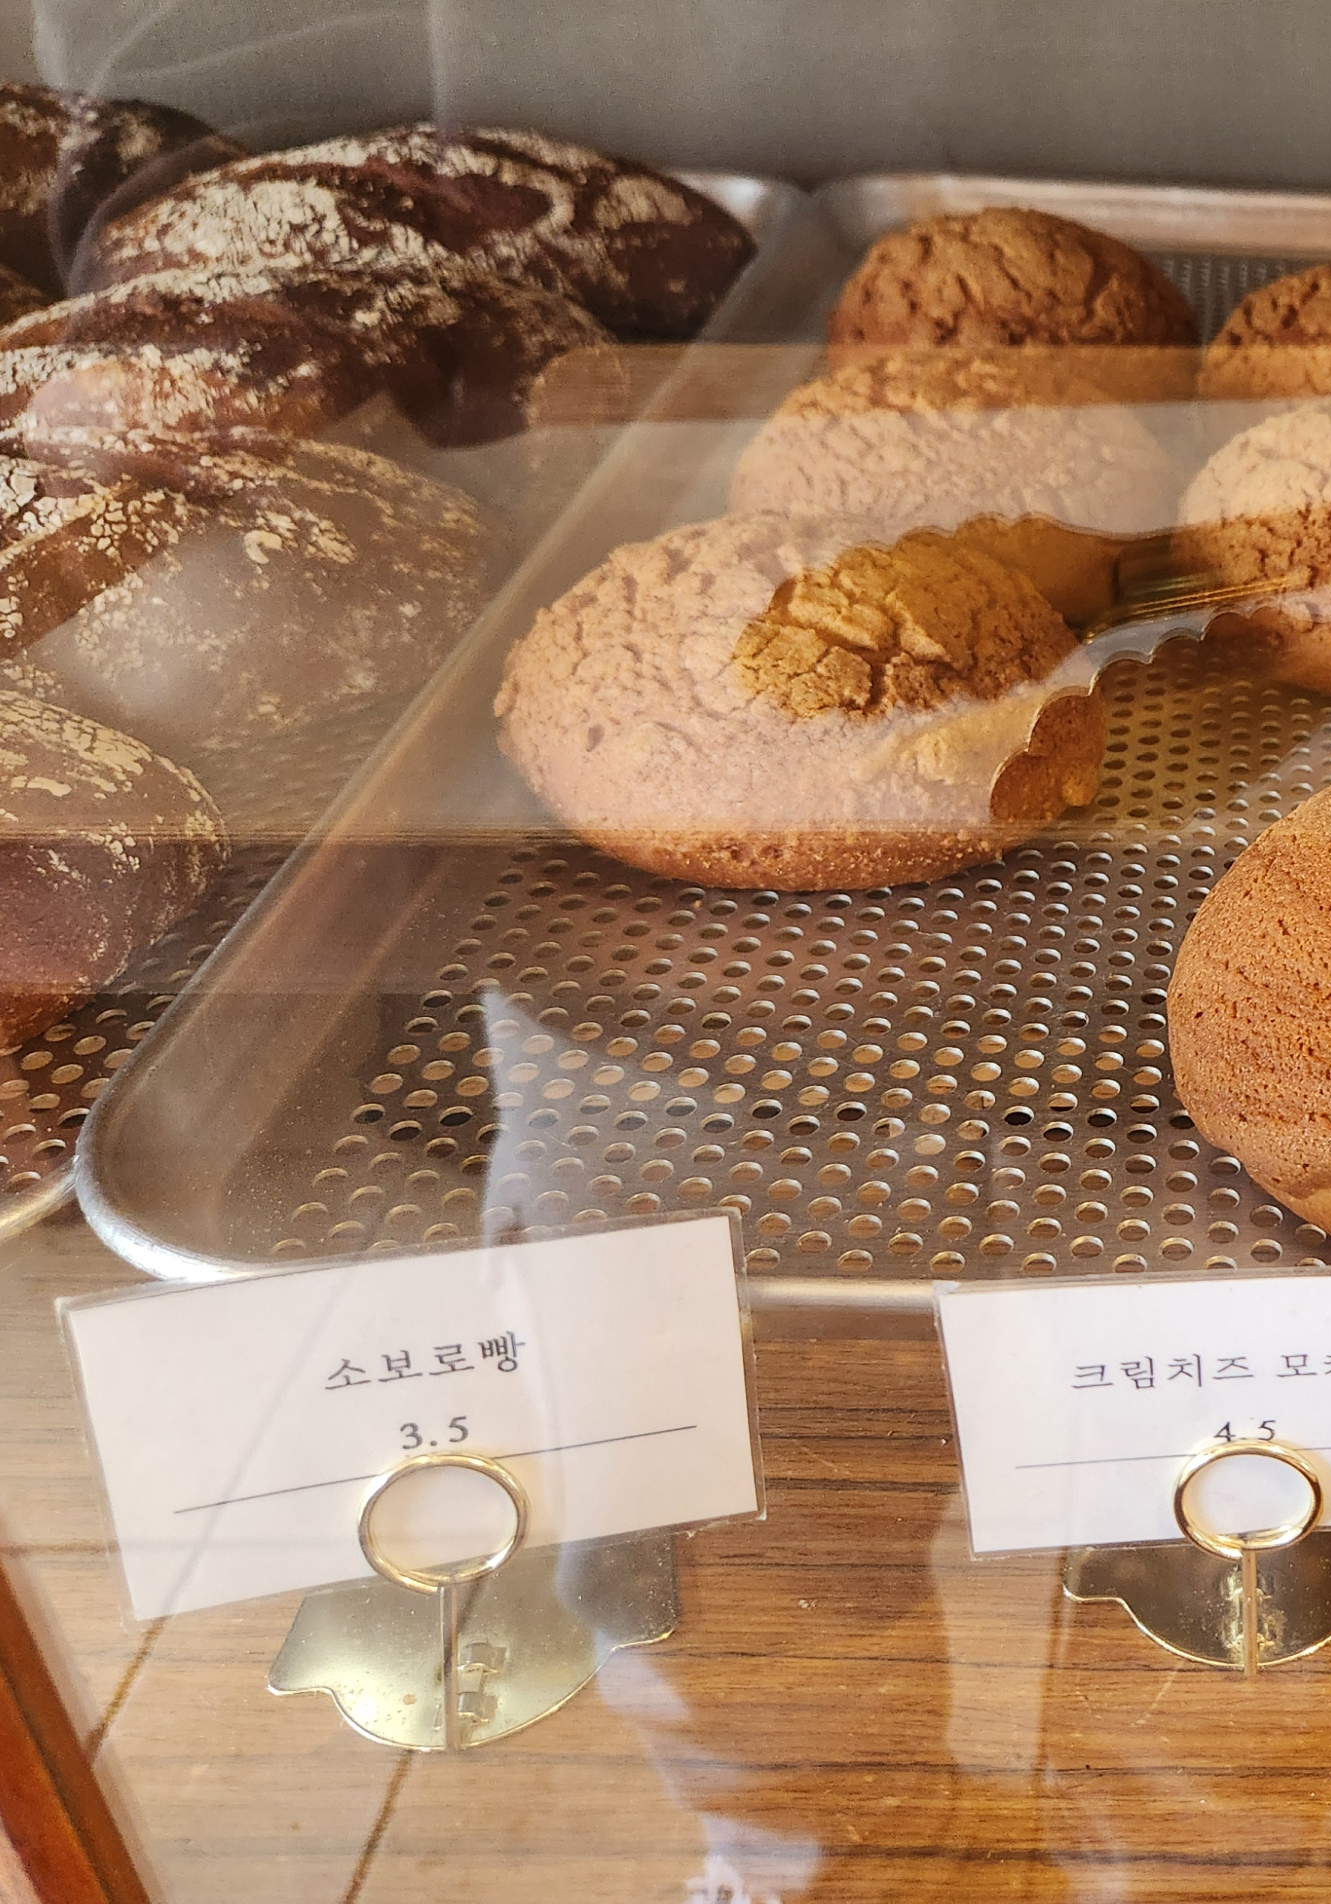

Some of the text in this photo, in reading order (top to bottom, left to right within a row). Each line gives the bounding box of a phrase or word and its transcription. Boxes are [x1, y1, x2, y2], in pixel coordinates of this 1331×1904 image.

[325, 1330, 526, 1390] 소보로빵
[1072, 1352, 1255, 1390] 크림치즈
[400, 1415, 468, 1450] 3.5
